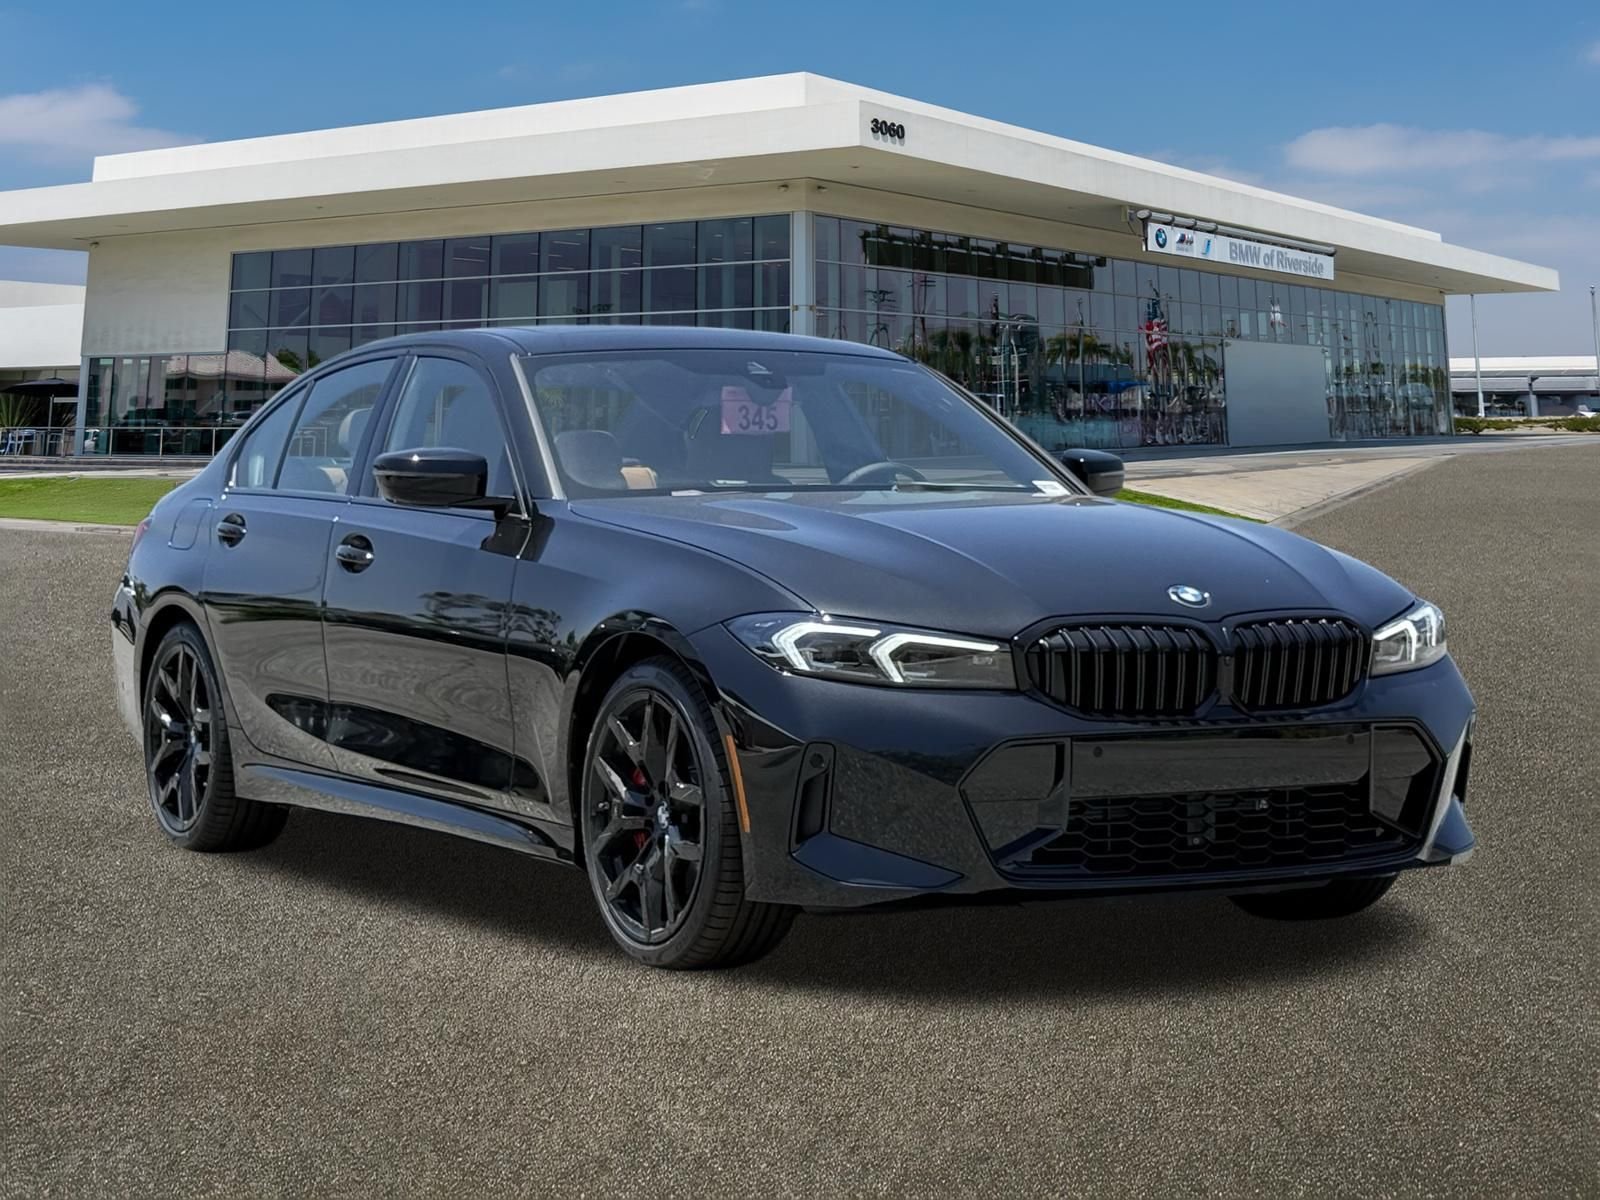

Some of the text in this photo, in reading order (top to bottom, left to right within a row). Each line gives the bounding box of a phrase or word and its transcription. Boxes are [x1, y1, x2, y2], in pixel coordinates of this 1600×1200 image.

[871, 118, 905, 139] 3060
[1229, 241, 1324, 275] BMW of Riverside
[738, 404, 778, 430] 345
